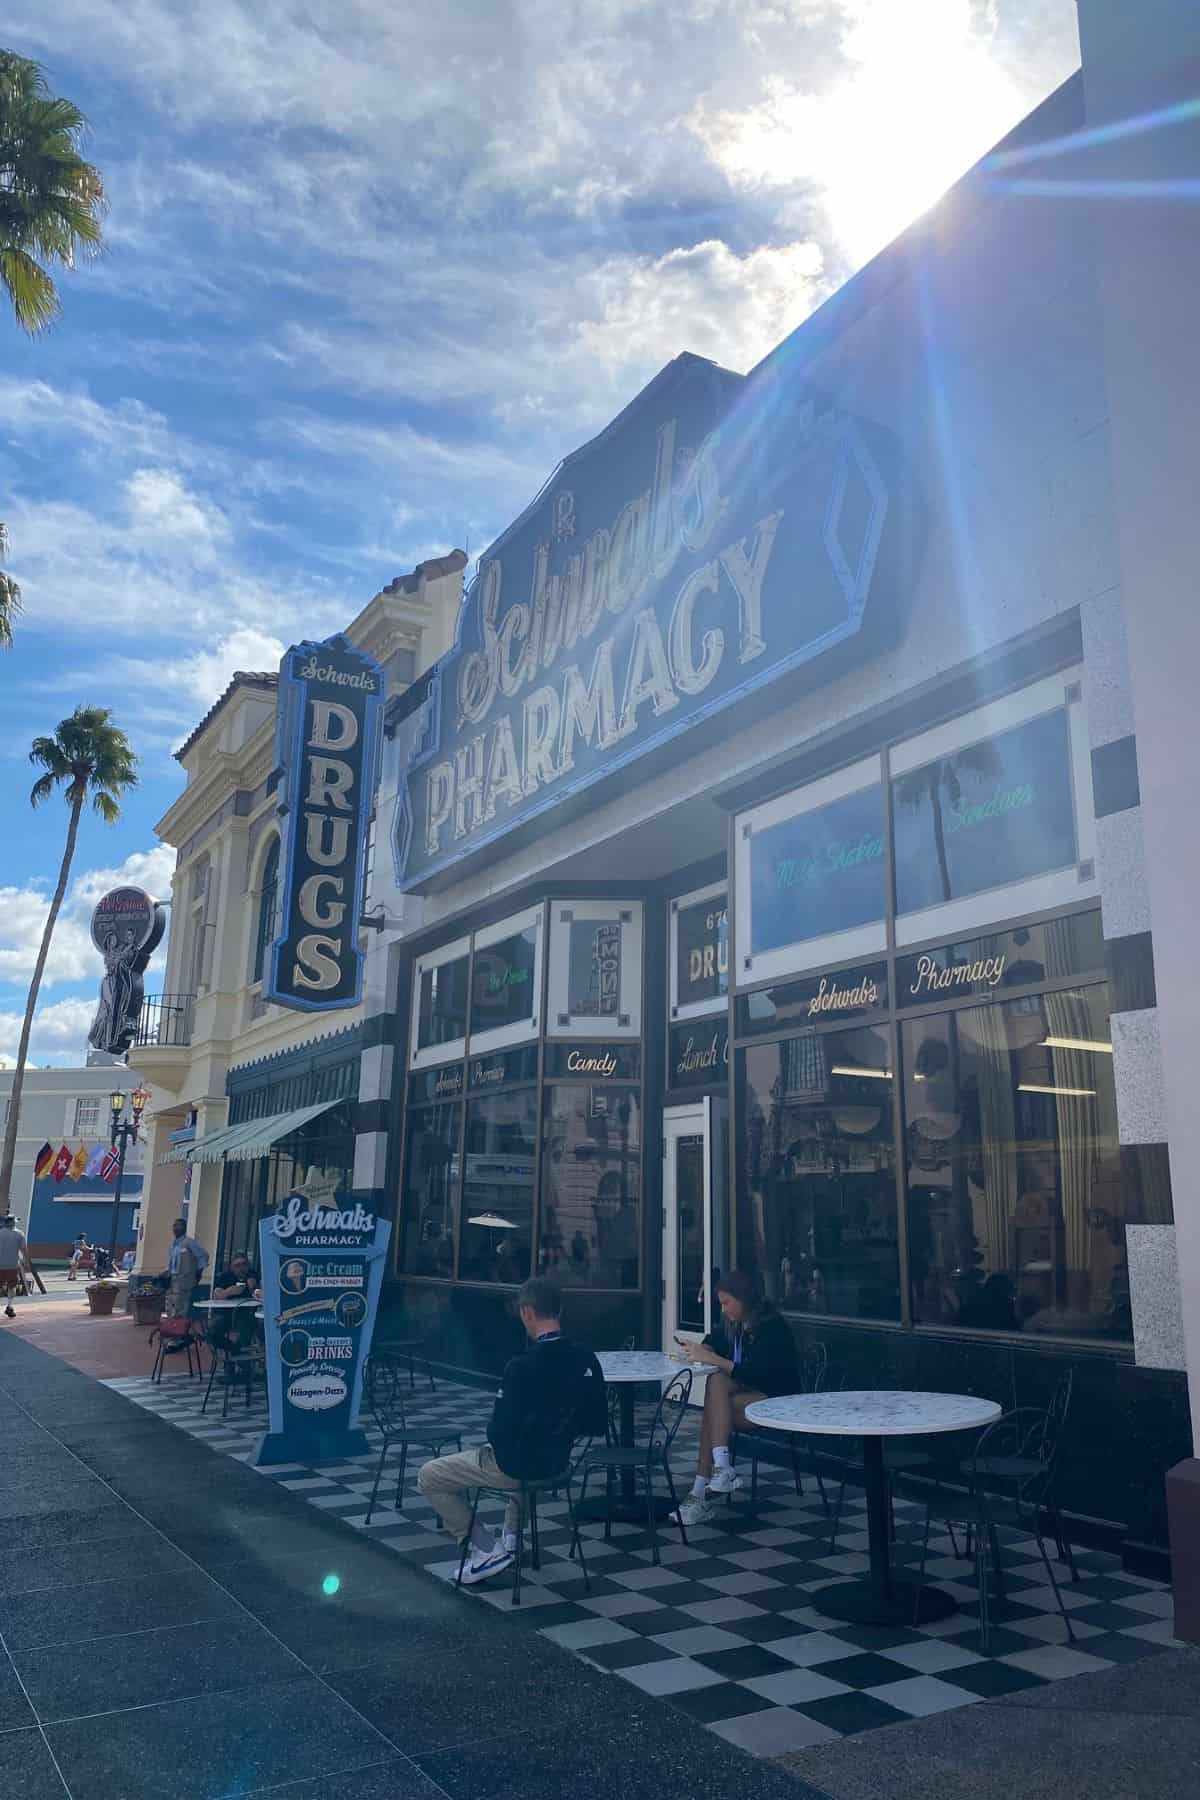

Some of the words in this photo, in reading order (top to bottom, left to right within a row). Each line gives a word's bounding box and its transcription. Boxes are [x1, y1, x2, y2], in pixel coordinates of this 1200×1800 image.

[302, 656, 376, 691] Schwab's
[424, 509, 784, 856] PHARMACY
[293, 699, 358, 991] DRUGS
[689, 940, 728, 983] DRU
[807, 976, 878, 1017] Schwab's
[910, 955, 1007, 994] Pharmacy
[566, 1050, 617, 1078] Candy
[676, 1032, 718, 1073] Lunch
[271, 1198, 375, 1238] Schwab's
[295, 1235, 362, 1246] PHARMACY
[306, 1263, 325, 1276] Ice
[327, 1262, 363, 1276] Cream
[308, 1345, 352, 1360] DRINKS
